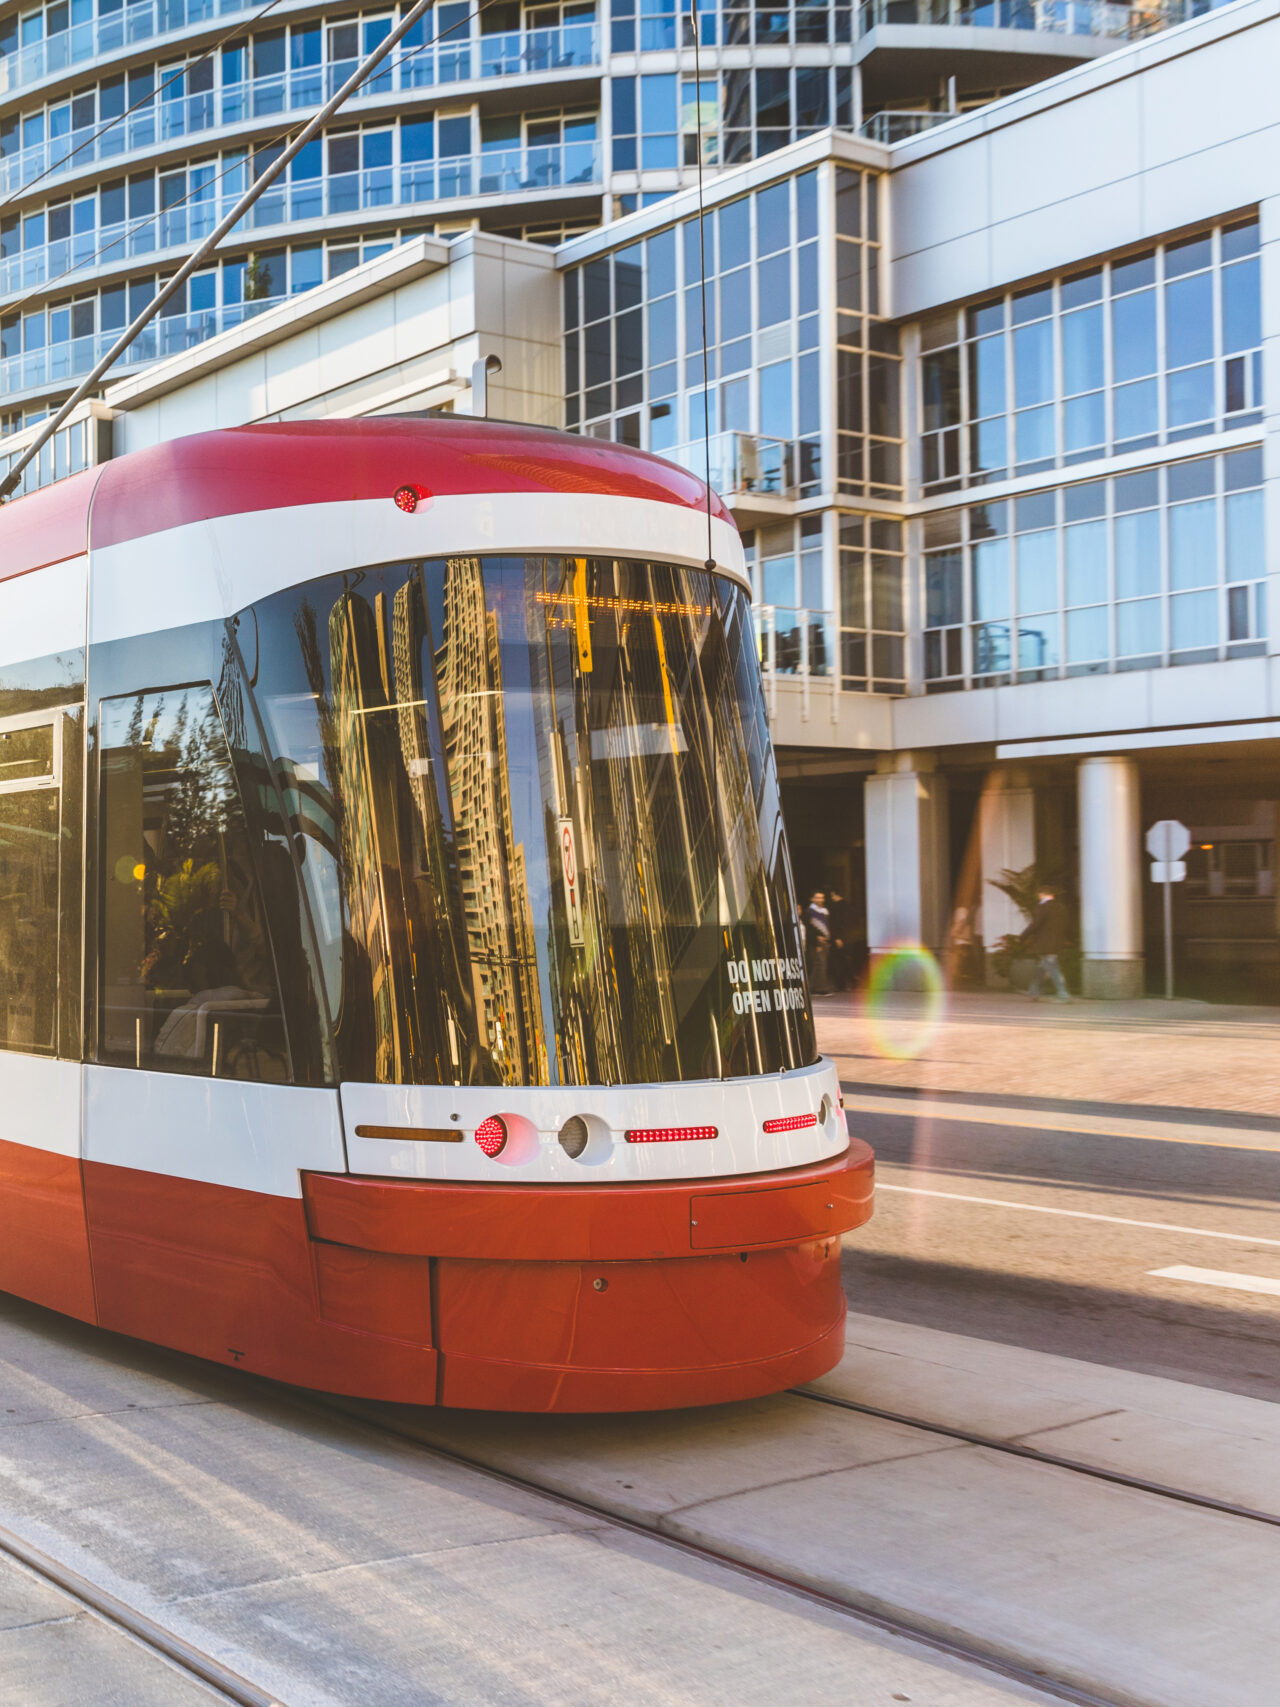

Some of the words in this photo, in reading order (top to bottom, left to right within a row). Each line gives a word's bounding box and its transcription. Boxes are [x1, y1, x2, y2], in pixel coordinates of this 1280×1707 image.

[727, 960, 749, 983] DO
[752, 958, 776, 981] NOT
[779, 957, 801, 979] PASS
[732, 990, 771, 1014] OPEN
[774, 988, 804, 1010] DOORS
